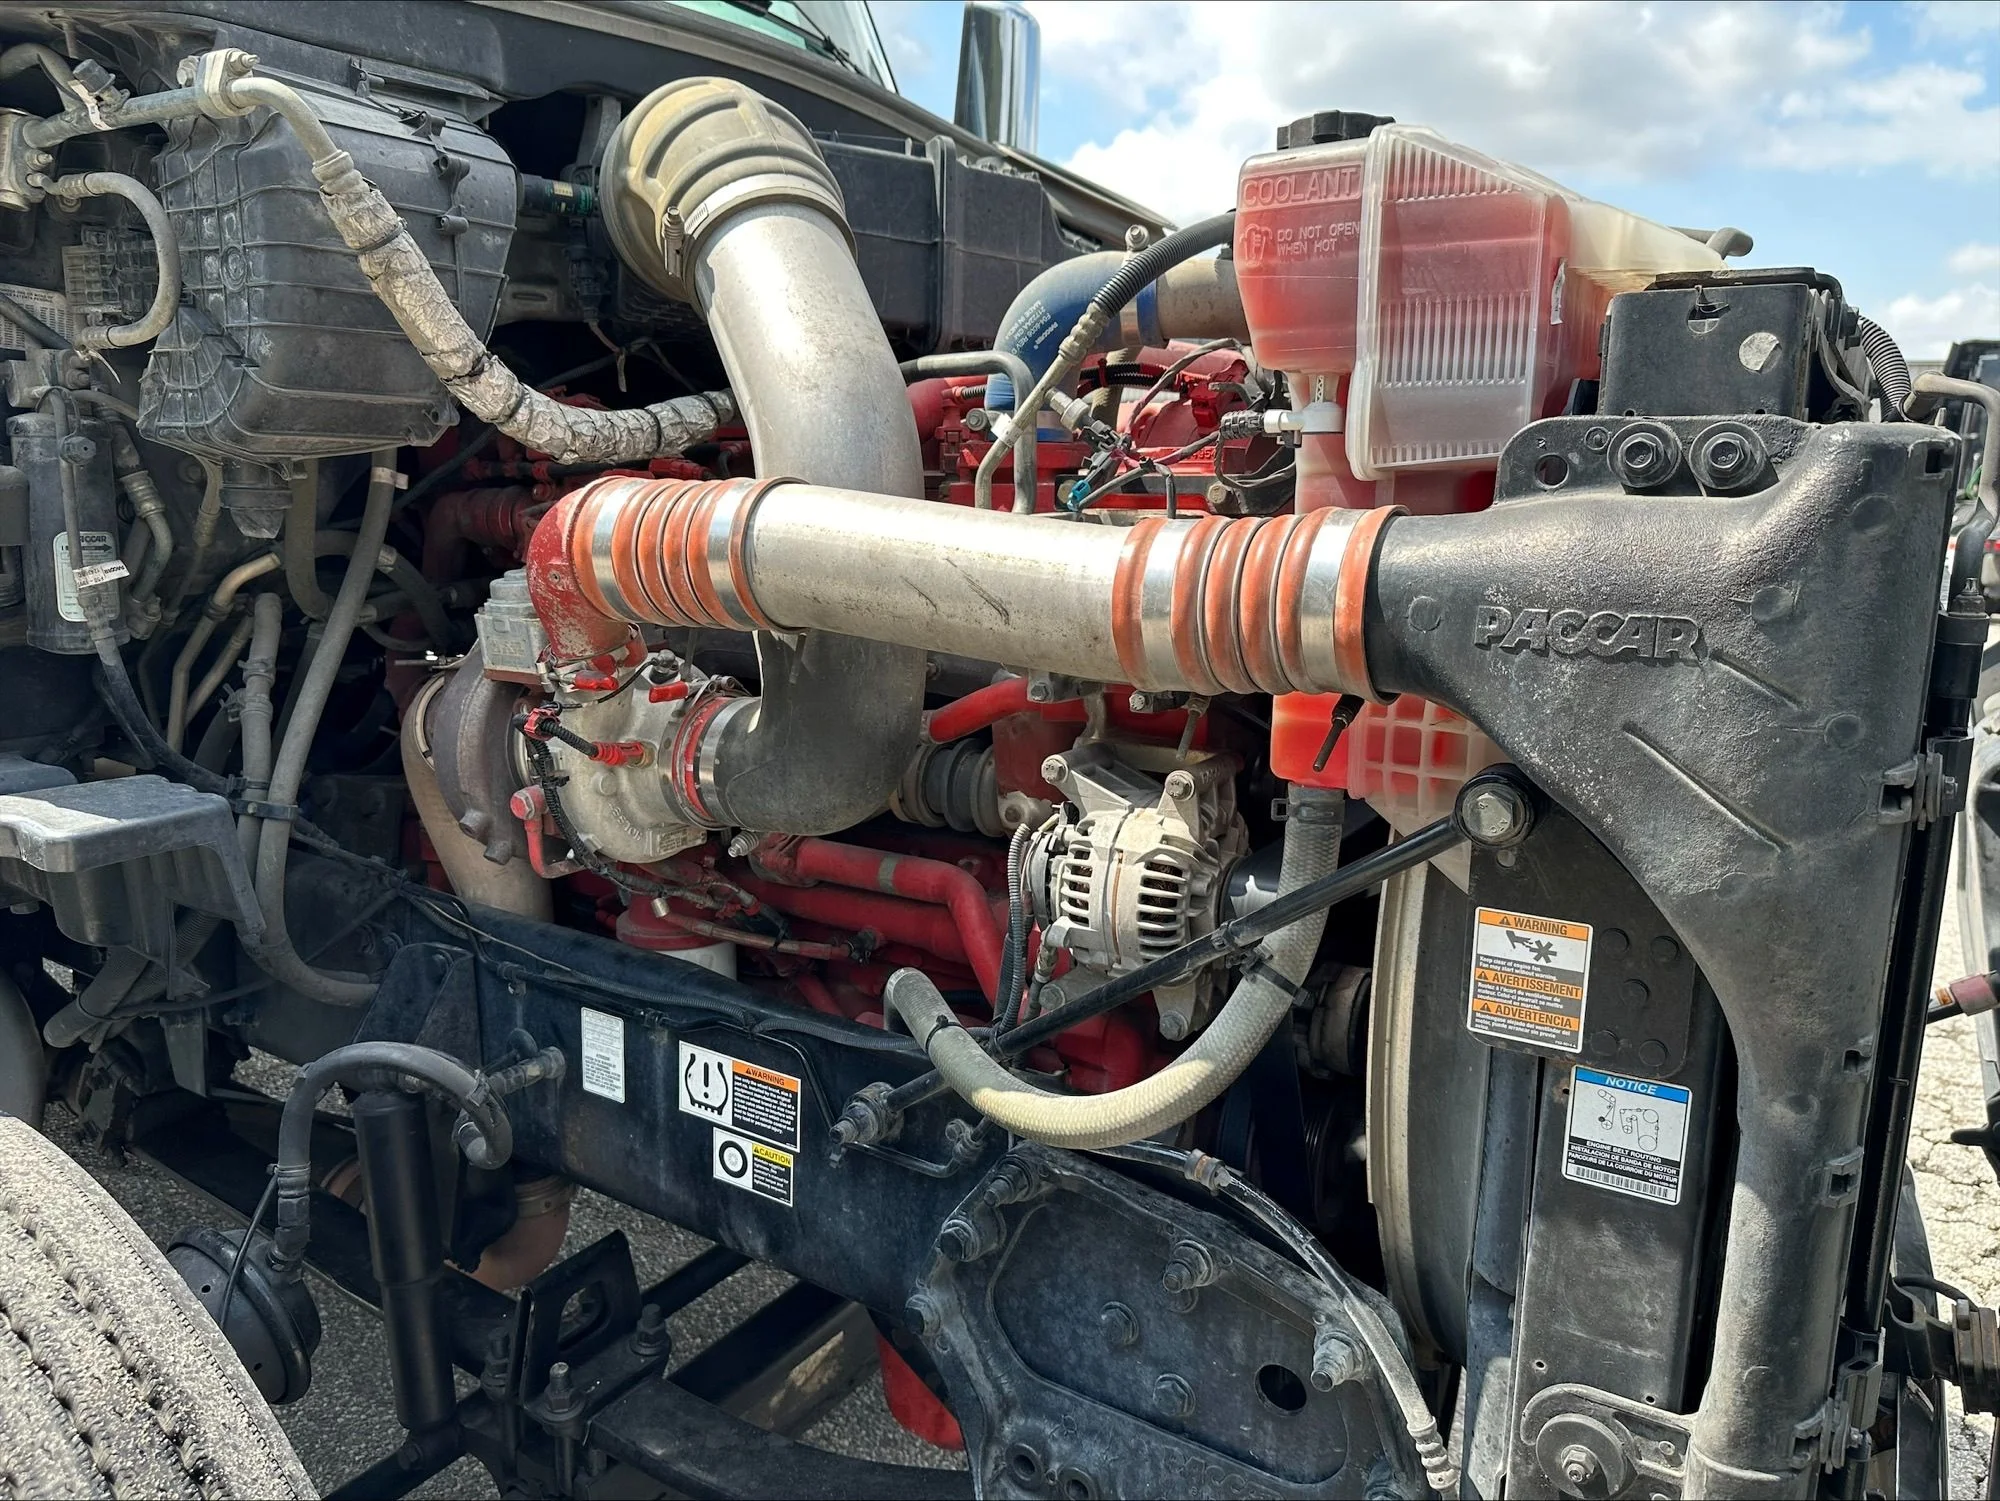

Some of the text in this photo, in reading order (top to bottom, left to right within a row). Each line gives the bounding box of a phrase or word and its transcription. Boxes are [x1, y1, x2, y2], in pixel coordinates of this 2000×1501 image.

[1243, 168, 1357, 205] COOLANT
[1277, 221, 1360, 242] DO NOT OPEN
[1277, 238, 1337, 257] WHEN HOT
[1474, 605, 1703, 660] PACCAR
[1513, 917, 1567, 935] WARNING
[1492, 972, 1580, 997] AVERTISSEMENT
[1495, 1004, 1572, 1028] ADVERTENCIA
[751, 1068, 784, 1085] WARNING
[1606, 1076, 1657, 1095] NOTICE
[760, 1147, 790, 1164] CAUTION
[1586, 1140, 1661, 1163] ENGINE BELT ROUTING
[1568, 1151, 1597, 1164] PARCOURS
[1598, 1158, 1605, 1166] DE
[1644, 1169, 1652, 1177] DU
[1653, 1171, 1677, 1182] MOTEUR
[1610, 1153, 1619, 1161] DE
[1620, 1156, 1642, 1166] BANDA
[1653, 1163, 1676, 1174] MOTOR
